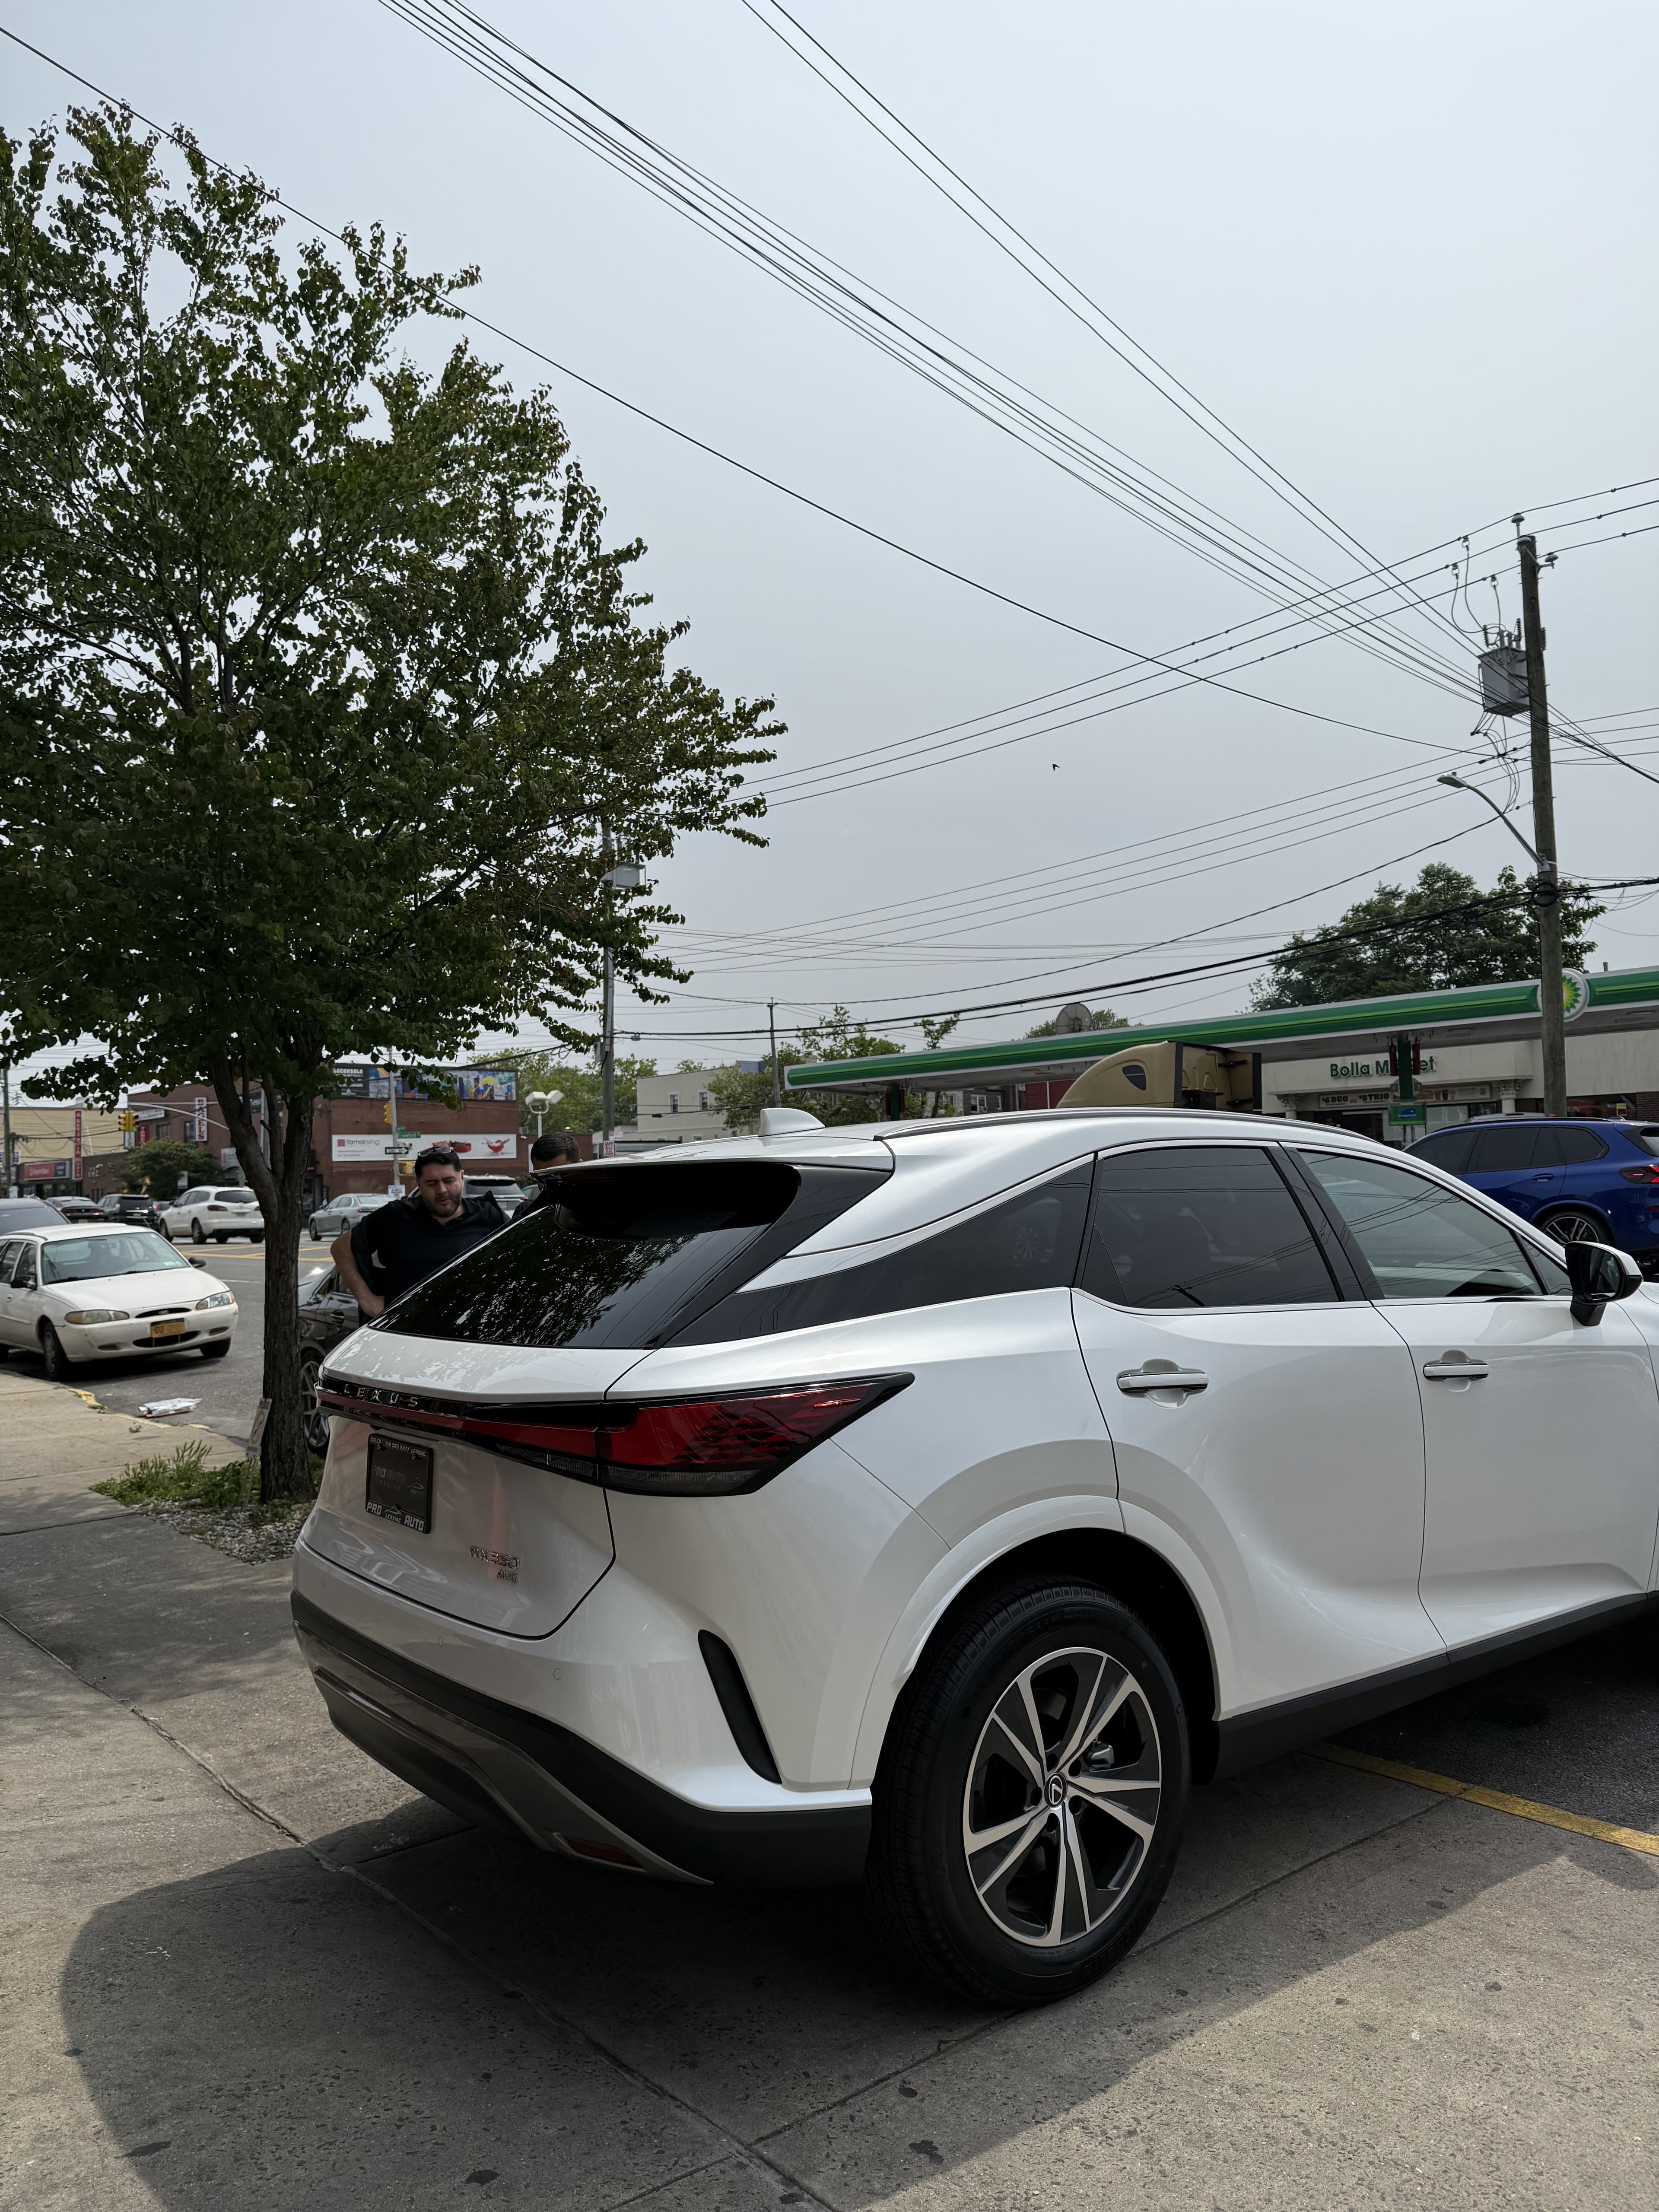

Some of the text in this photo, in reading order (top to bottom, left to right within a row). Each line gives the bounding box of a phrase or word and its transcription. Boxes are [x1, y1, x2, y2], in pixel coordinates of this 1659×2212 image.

[1330, 1056, 1436, 1077] Bolla Met
[344, 1384, 419, 1407] LEXUS
[411, 1448, 427, 1457] LEASING
[367, 1501, 425, 1532] PRO AUTO
[385, 1513, 401, 1523] LEASING
